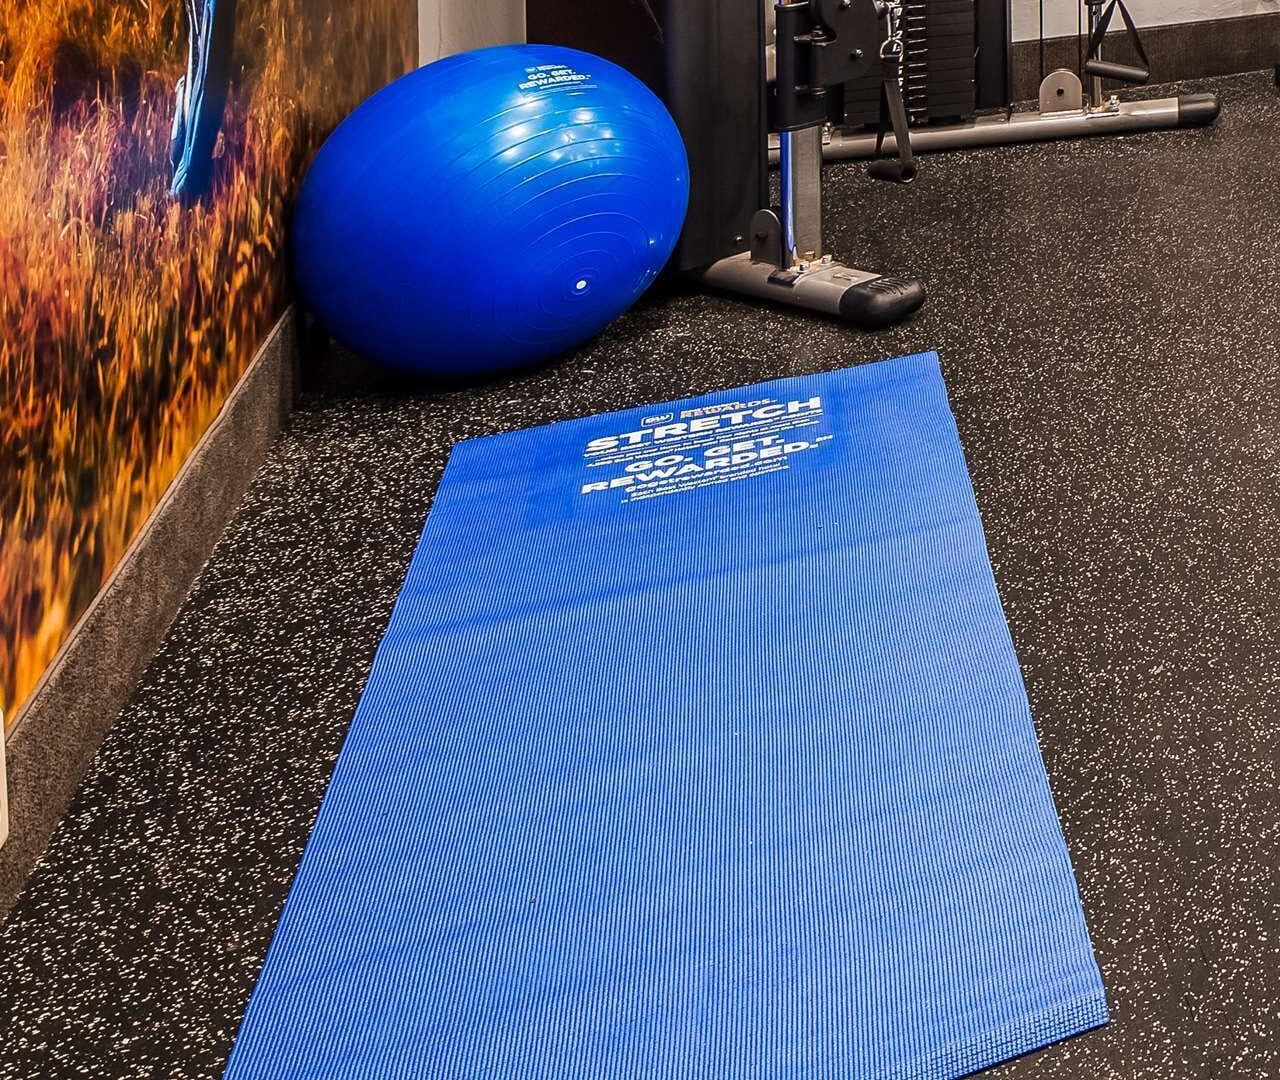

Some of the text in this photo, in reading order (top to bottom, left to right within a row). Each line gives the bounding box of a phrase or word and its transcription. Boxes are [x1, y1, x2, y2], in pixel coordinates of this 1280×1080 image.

[585, 396, 821, 452] STRETCH
[581, 441, 819, 495] REWARDED.
[625, 455, 693, 473] GO.
[704, 435, 785, 457] GET.
